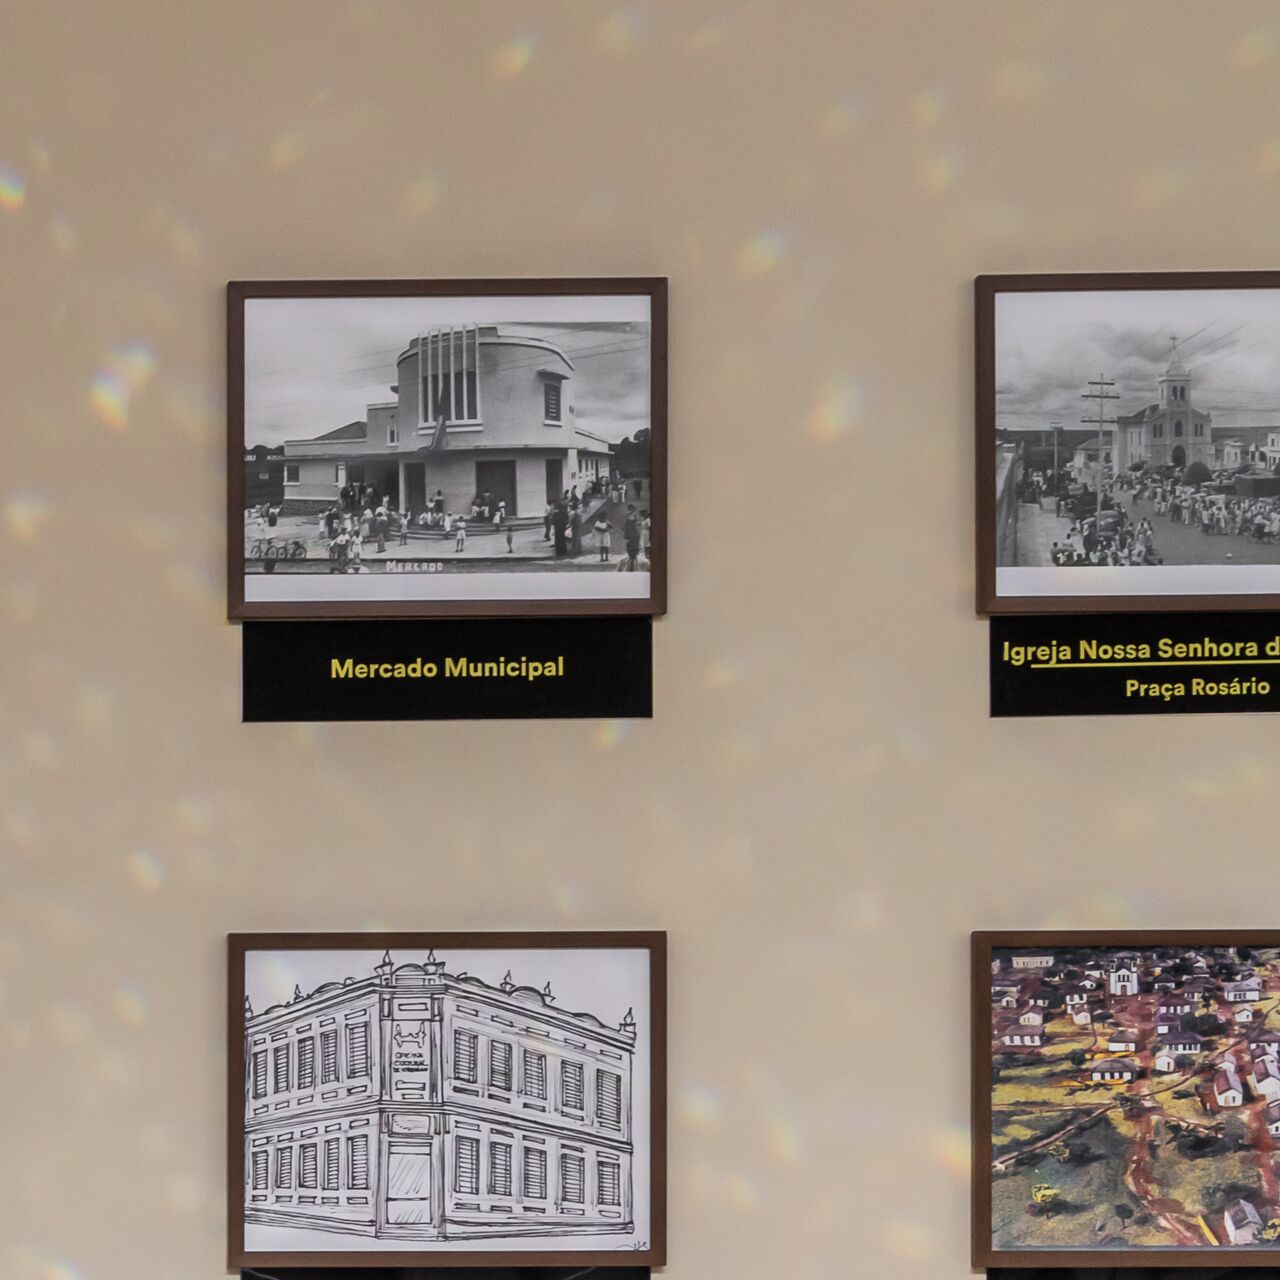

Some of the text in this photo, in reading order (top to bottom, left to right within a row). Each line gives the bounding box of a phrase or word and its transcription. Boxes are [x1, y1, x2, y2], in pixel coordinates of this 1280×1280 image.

[1003, 640, 1072, 666] Igreja
[1079, 638, 1151, 660] Nossa
[1158, 636, 1258, 658] Senhora
[331, 655, 564, 681] Mercado Municipal
[1126, 676, 1271, 701] Praça Rosário
